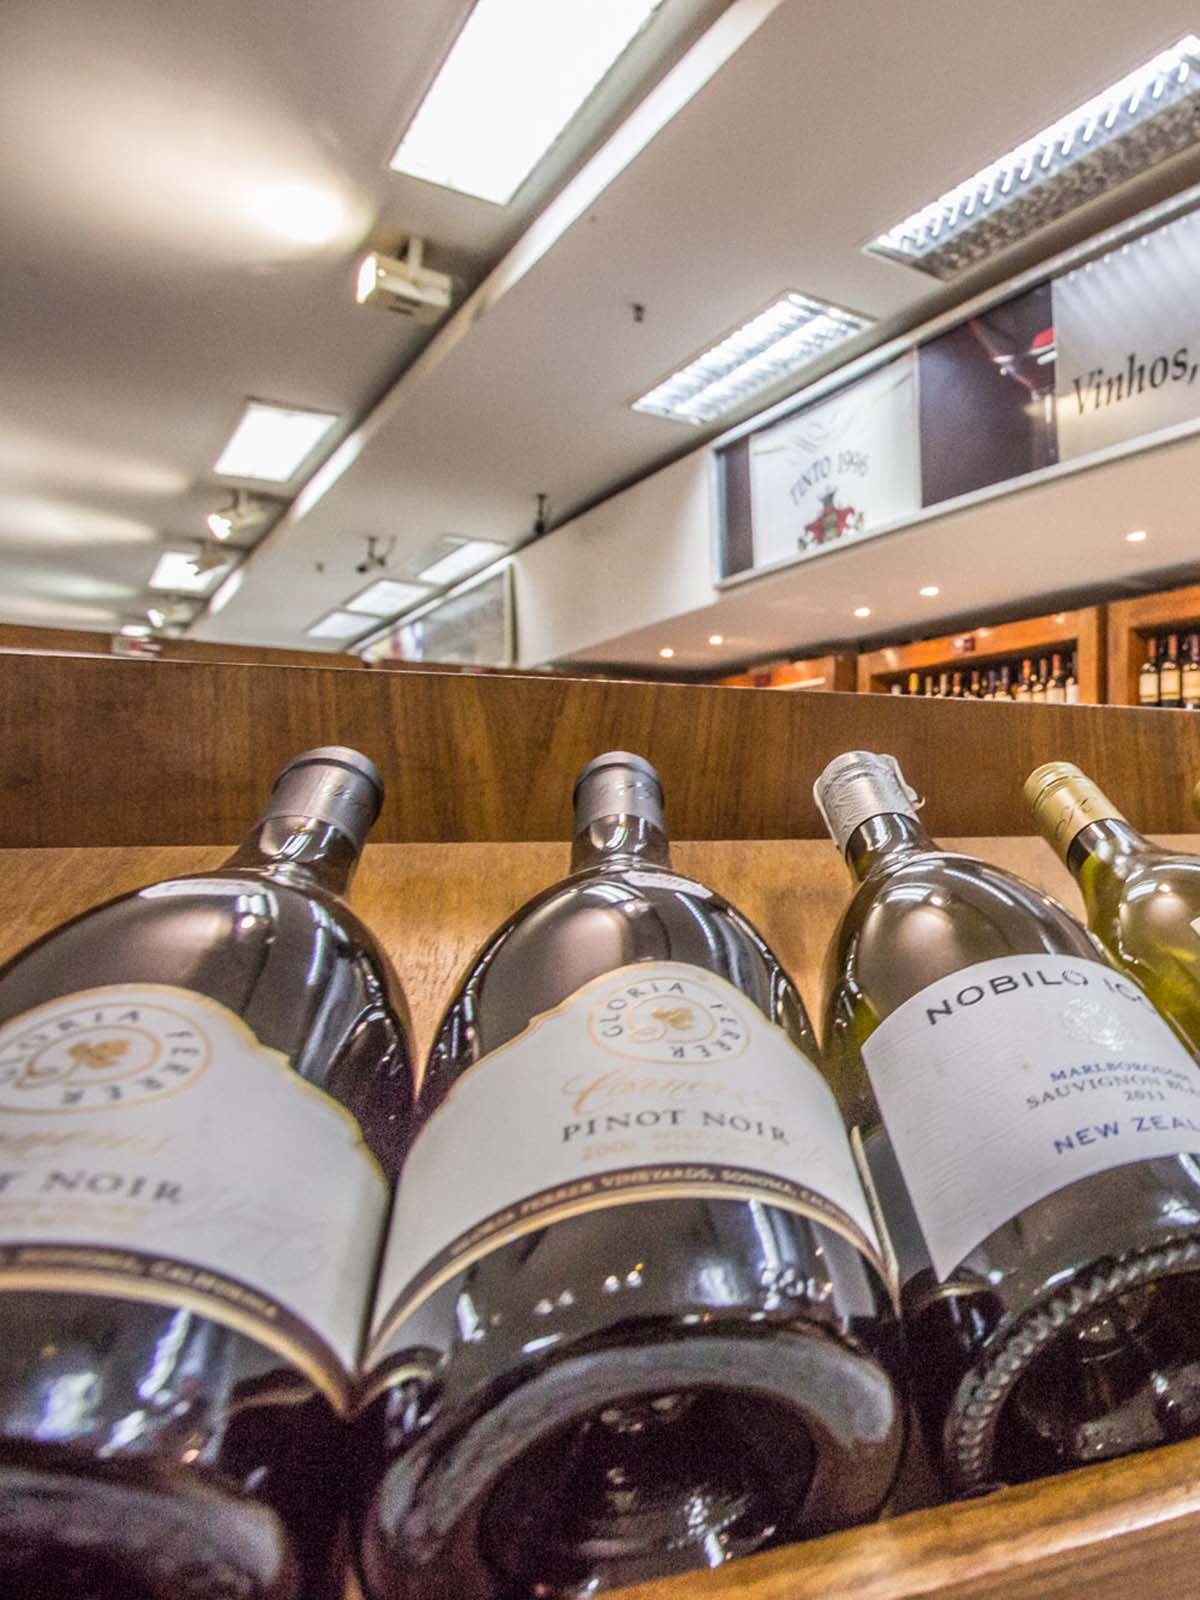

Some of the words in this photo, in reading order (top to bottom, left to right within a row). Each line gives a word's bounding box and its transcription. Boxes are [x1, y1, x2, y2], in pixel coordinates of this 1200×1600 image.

[1072, 346, 1199, 416] Vinhos,
[599, 982, 685, 1038] GLORIA
[925, 969, 1089, 1026] NOBILO
[562, 1109, 686, 1144] PINOT
[701, 1110, 791, 1147] NOIR
[1053, 1121, 1119, 1155] NEW
[42, 1170, 184, 1205] NOIR
